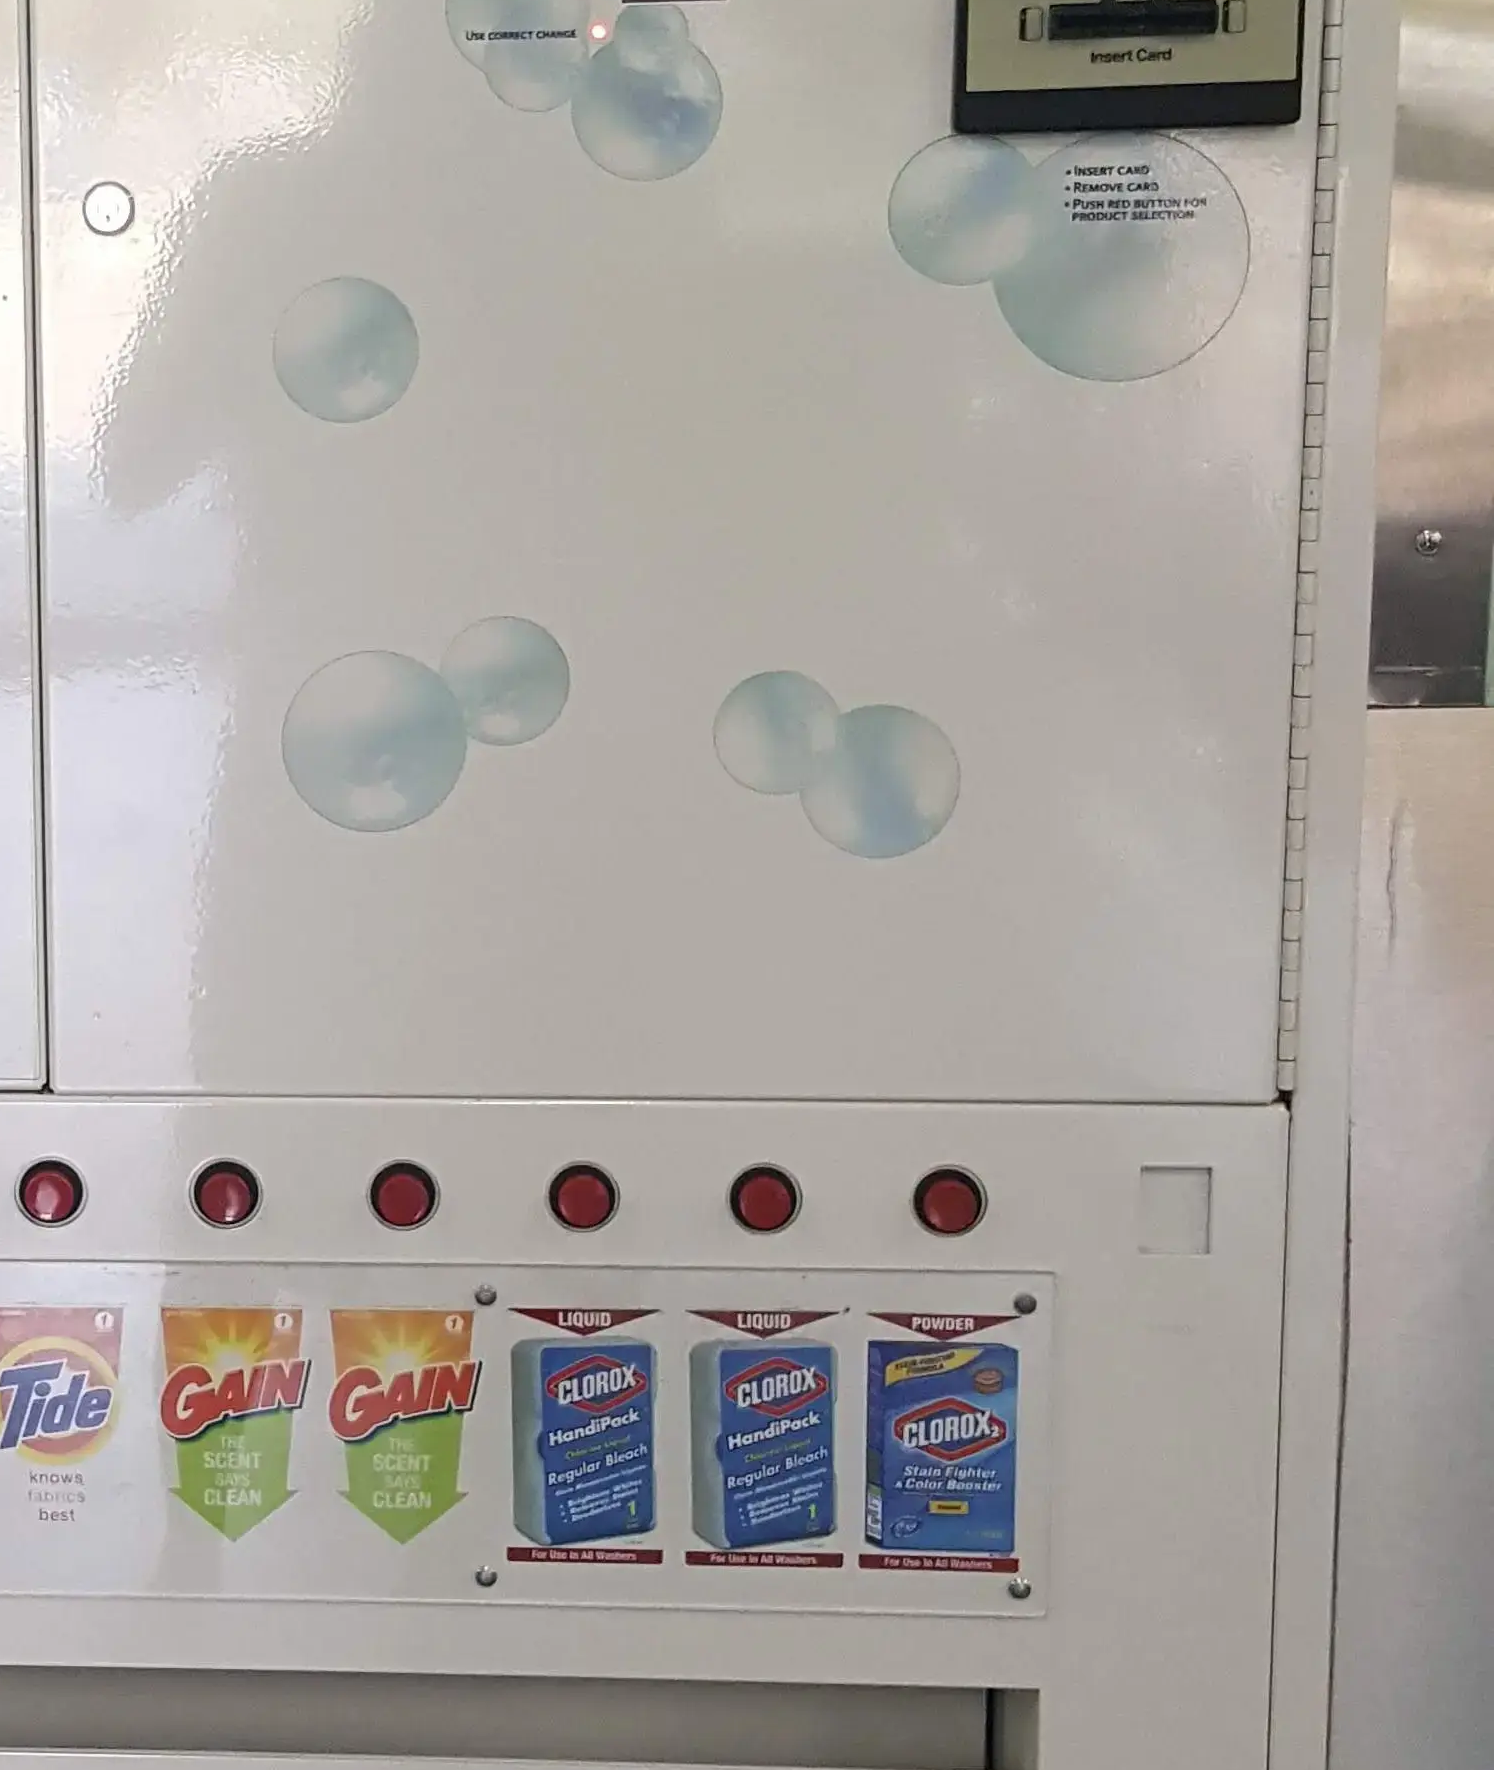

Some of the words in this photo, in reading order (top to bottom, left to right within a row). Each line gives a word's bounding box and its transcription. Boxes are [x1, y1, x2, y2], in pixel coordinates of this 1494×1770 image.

[488, 31, 532, 40] CORRECT
[536, 29, 576, 39] CHANGE
[1091, 49, 1133, 63] Insert
[1136, 48, 1172, 62] Card
[1074, 165, 1114, 176] INSERT
[1117, 165, 1150, 176] CARD
[1073, 182, 1124, 193] REMOVE
[1127, 182, 1159, 192] CARD
[1107, 199, 1131, 209] RED
[1134, 199, 1181, 209] BUTTON
[1071, 211, 1127, 221] PRODUCT
[1131, 210, 1195, 220] SELECTION
[558, 1311, 612, 1328] LIQUID
[737, 1313, 791, 1329] LIQUID
[912, 1316, 975, 1330] POWDER
[558, 1363, 638, 1405] CLOROX
[737, 1367, 817, 1408] CLOROX
[0, 1360, 111, 1450] Tide
[162, 1360, 308, 1438] GAIN
[330, 1361, 478, 1440] GAIN
[549, 1407, 641, 1446] HandiPack
[727, 1411, 821, 1450] HandiPack
[204, 1452, 262, 1469] SCENT
[373, 1454, 432, 1472] SCENT
[548, 1460, 602, 1486] Regular
[605, 1443, 648, 1467] Bleach
[727, 1465, 782, 1490] Regular
[785, 1445, 829, 1470] Bleach
[29, 1470, 84, 1484] knows
[903, 1465, 941, 1477] Stain
[945, 1465, 997, 1479] Fighter
[905, 1478, 944, 1490] Color
[946, 1479, 1002, 1491] Booster
[204, 1489, 262, 1506] CLEAN
[373, 1492, 432, 1509] CLEAN
[38, 1507, 75, 1521] best
